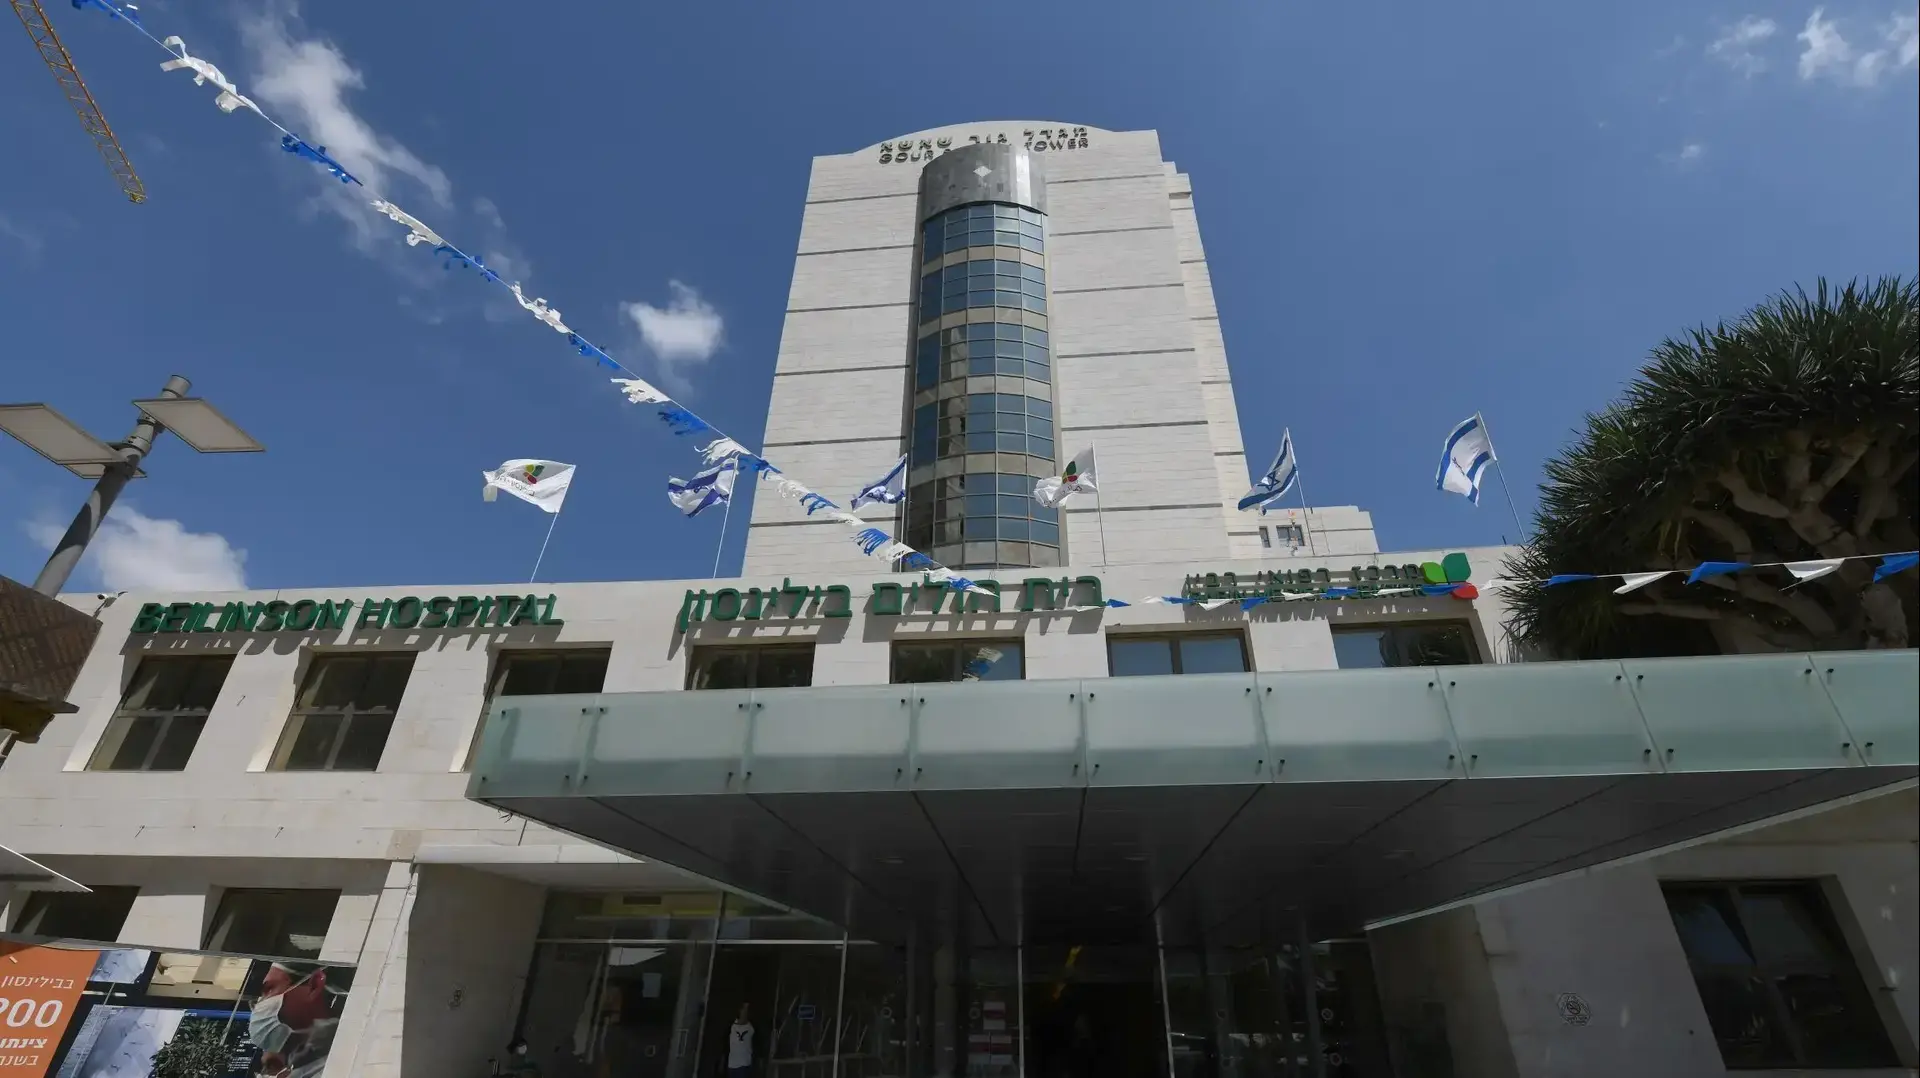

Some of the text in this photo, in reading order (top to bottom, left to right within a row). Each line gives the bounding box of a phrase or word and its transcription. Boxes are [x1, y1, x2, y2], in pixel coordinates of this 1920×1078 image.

[1023, 127, 1088, 141] מגדל
[878, 150, 934, 165] GOUR
[1024, 138, 1089, 152] TOWER
[1351, 563, 1419, 581] מרכז
[130, 593, 565, 633] BEILINSON HOSPITAL
[679, 571, 1107, 634] בית חולים בילינסון
[1, 975, 75, 989] בבילינסון
